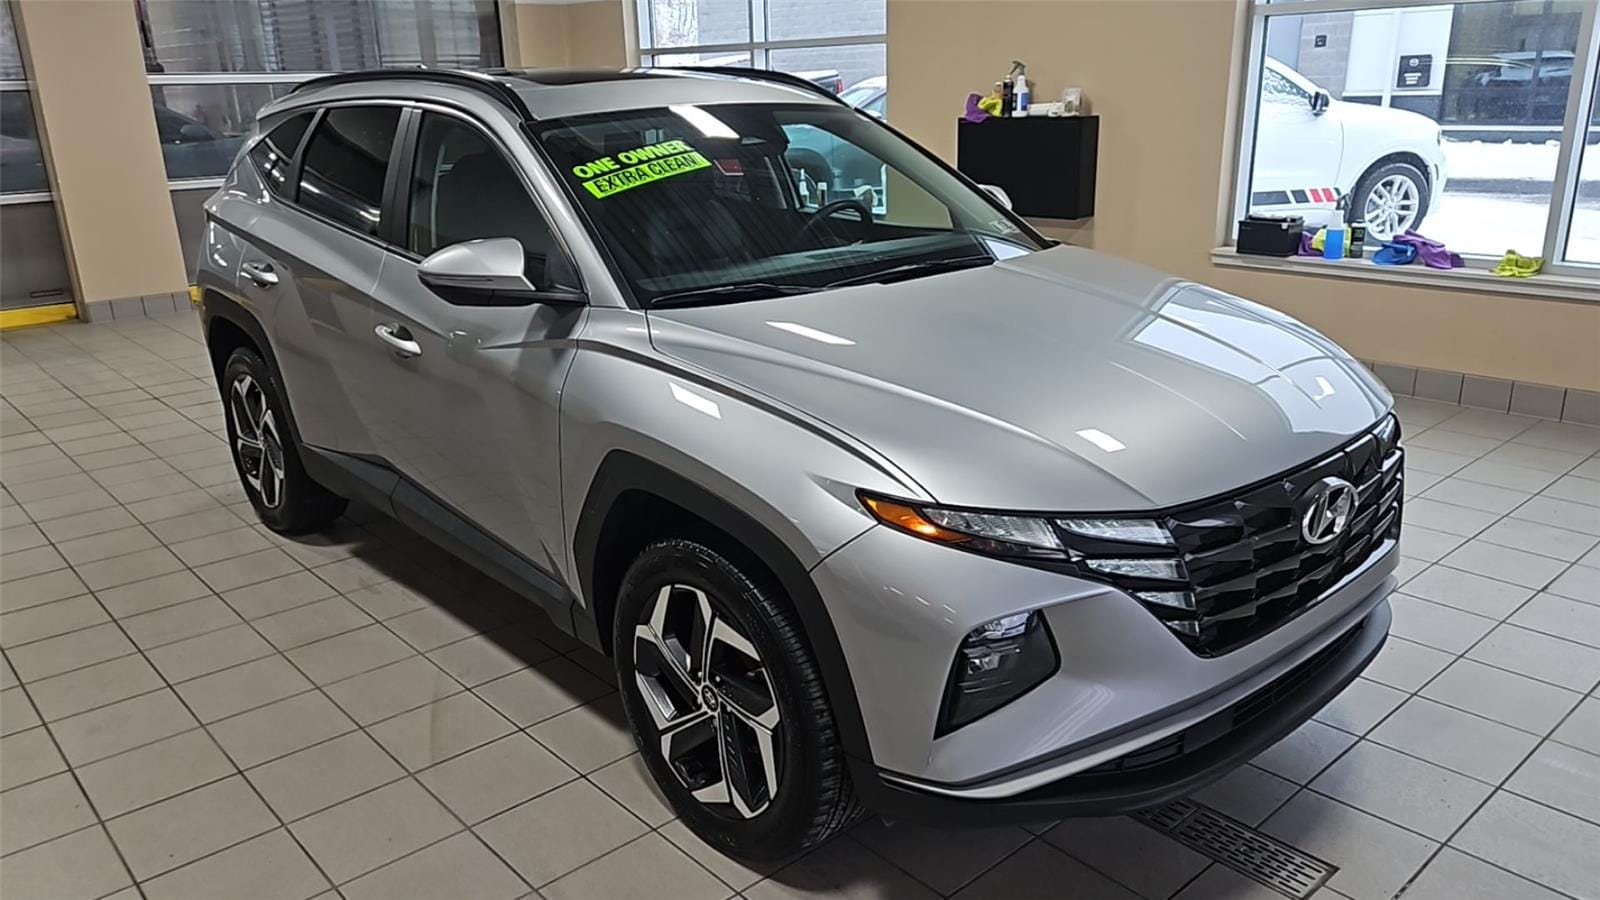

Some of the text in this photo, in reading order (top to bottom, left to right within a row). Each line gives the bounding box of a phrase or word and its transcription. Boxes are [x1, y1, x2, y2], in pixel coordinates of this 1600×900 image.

[573, 140, 695, 178] ONE OWNER
[593, 153, 699, 193] EXTRA CLEAN
